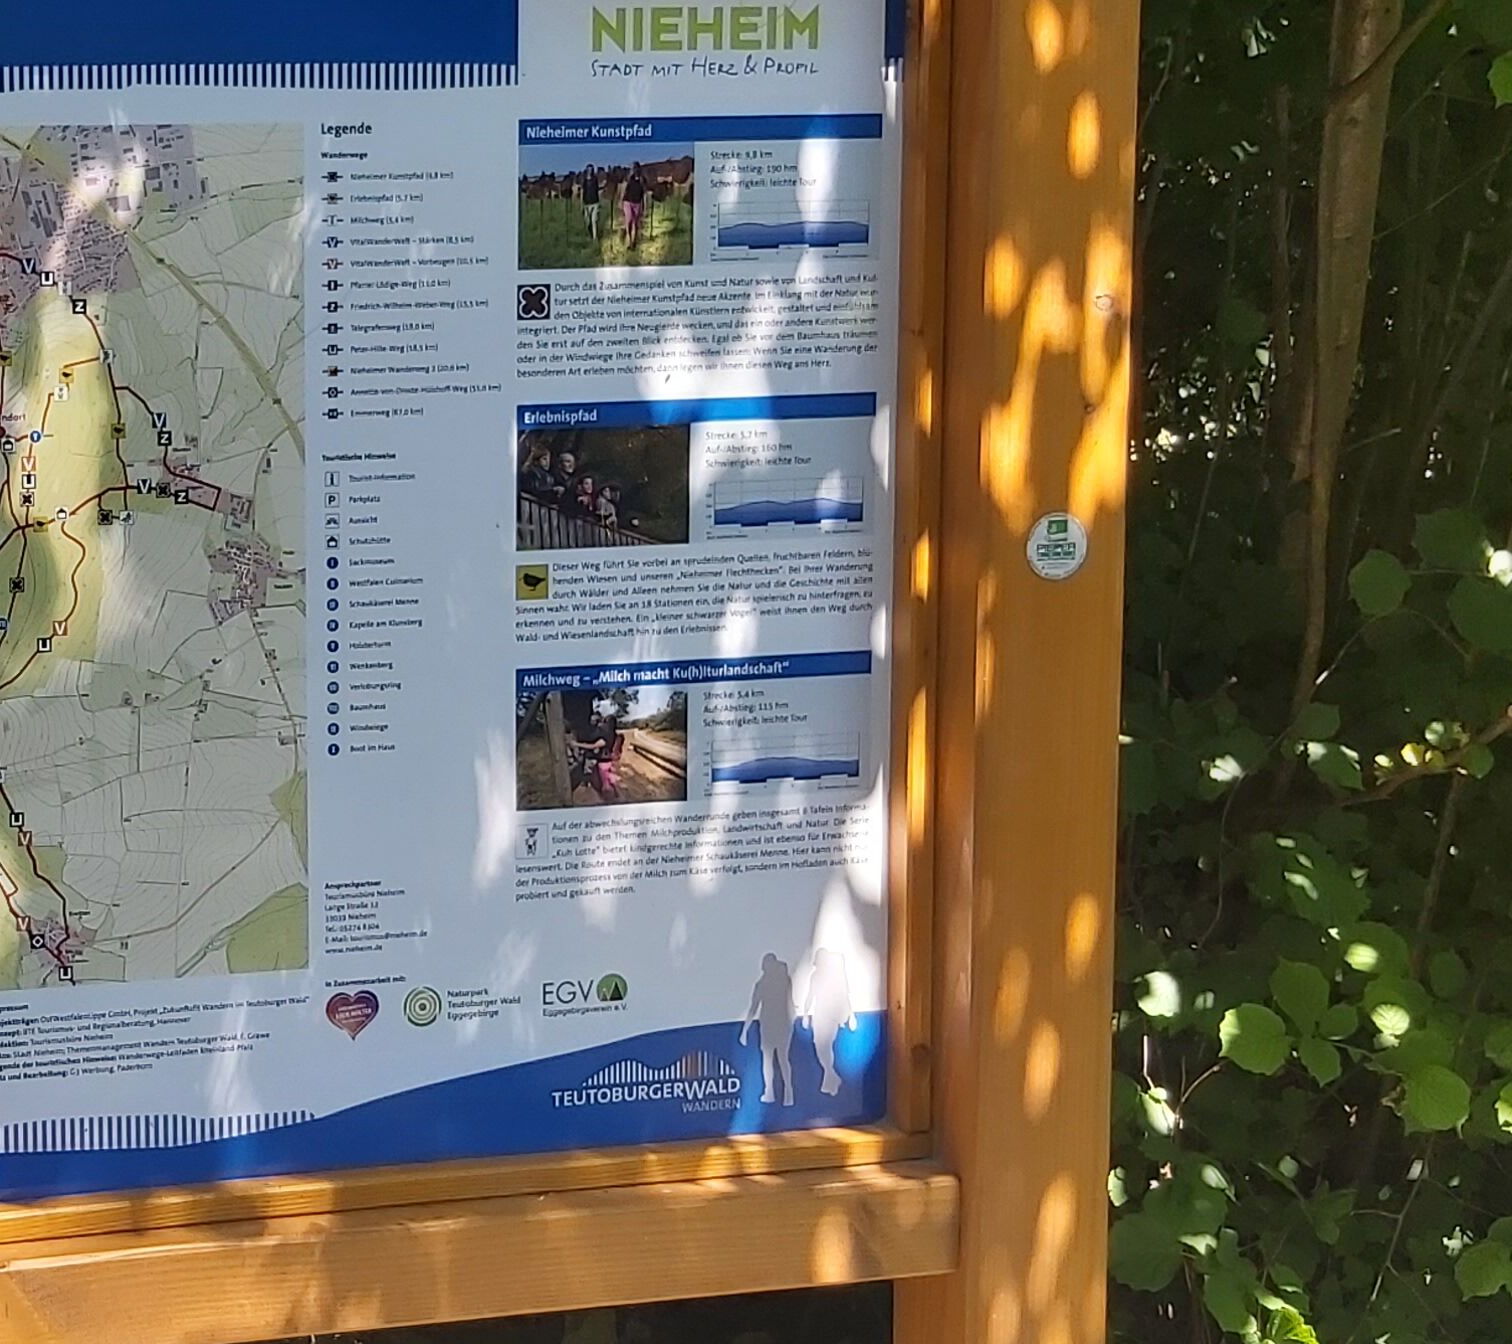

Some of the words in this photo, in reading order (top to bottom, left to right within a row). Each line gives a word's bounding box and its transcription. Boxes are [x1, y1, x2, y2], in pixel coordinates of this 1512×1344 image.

[592, 4, 819, 52] NIEHEIM
[744, 55, 757, 75] &
[321, 123, 372, 137] Legende
[526, 125, 588, 139] Nieheimer
[591, 123, 652, 141] Kunstpfad
[555, 283, 580, 291] Durch
[582, 282, 597, 290] das
[686, 279, 708, 287] Kunst
[729, 278, 753, 286] Natur
[591, 296, 604, 304] der
[608, 295, 649, 303] Nieheimer
[652, 294, 694, 305] Kunstpfad
[804, 290, 817, 298] mit
[835, 289, 857, 297] Natur
[554, 311, 570, 319] den
[572, 310, 604, 321] Objekte
[624, 308, 687, 317] internationalen
[562, 325, 576, 333] Der
[599, 324, 617, 332] wird
[517, 341, 533, 349] den
[536, 340, 548, 348] Sie
[552, 340, 567, 348] erst
[570, 339, 585, 347] auf
[606, 338, 638, 346] zweiten
[642, 337, 660, 345] Blick
[517, 354, 536, 362] oder
[549, 353, 563, 361] der
[567, 352, 613, 363] Windwiege
[780, 346, 792, 354] Sie
[815, 344, 861, 355] Wanderung
[517, 368, 565, 377] besonderen
[583, 366, 614, 375] erleben
[774, 360, 792, 371] Weg
[811, 359, 831, 367] Herz.
[524, 410, 597, 428] Erlebnispfad
[794, 456, 811, 464] Tour
[553, 563, 578, 572] Dieser
[581, 562, 600, 573] Weg
[603, 561, 624, 570] führt
[628, 560, 640, 568] Sie
[642, 559, 667, 568] vorbei
[553, 576, 583, 585] henden
[587, 574, 618, 583] Wiesen
[621, 573, 637, 581] und
[789, 566, 801, 574] Bei
[826, 562, 873, 575] Wanderung
[552, 590, 576, 599] durch
[580, 588, 609, 597] Wälder
[613, 587, 628, 596] und
[632, 586, 657, 595] Alleen
[661, 584, 695, 594] nehmen
[713, 583, 725, 591] die
[728, 582, 752, 591] Natur
[755, 581, 771, 589] und
[774, 580, 787, 588] die
[789, 578, 834, 588] Geschichte
[516, 605, 545, 614] Sinnen
[589, 602, 612, 611] laden
[654, 598, 693, 608] Stationen
[516, 619, 555, 628] erkennen
[558, 617, 574, 626] und
[811, 605, 825, 613] den
[828, 604, 846, 615] Weg
[849, 603, 872, 611] durch
[543, 632, 559, 640] und
[561, 628, 634, 639] Wiesenlandschaft
[663, 626, 678, 634] den
[523, 672, 580, 690] Milchweg
[593, 670, 630, 686] „Milch
[634, 667, 669, 681] macht
[673, 662, 789, 682] Ku(h)lturlandschaft“
[569, 820, 582, 829] der
[596, 832, 611, 841] den
[614, 830, 647, 840] Themen
[566, 861, 578, 870] Die
[792, 847, 808, 856] Hier
[811, 846, 830, 855] kann
[516, 878, 529, 887] der
[532, 873, 611, 889] Produktionsprozess
[645, 869, 667, 878] Milch
[791, 859, 828, 869] Hofladen
[516, 890, 549, 902] probiert
[552, 889, 567, 898] und
[447, 988, 488, 997] Naturpark
[543, 980, 593, 1005] EGV
[448, 998, 498, 1008] Teutoburger
[448, 1009, 498, 1020] Eggegebirge
[552, 1078, 740, 1107] TEUTOBURGERWALD
[682, 1099, 740, 1112] WANDERN
